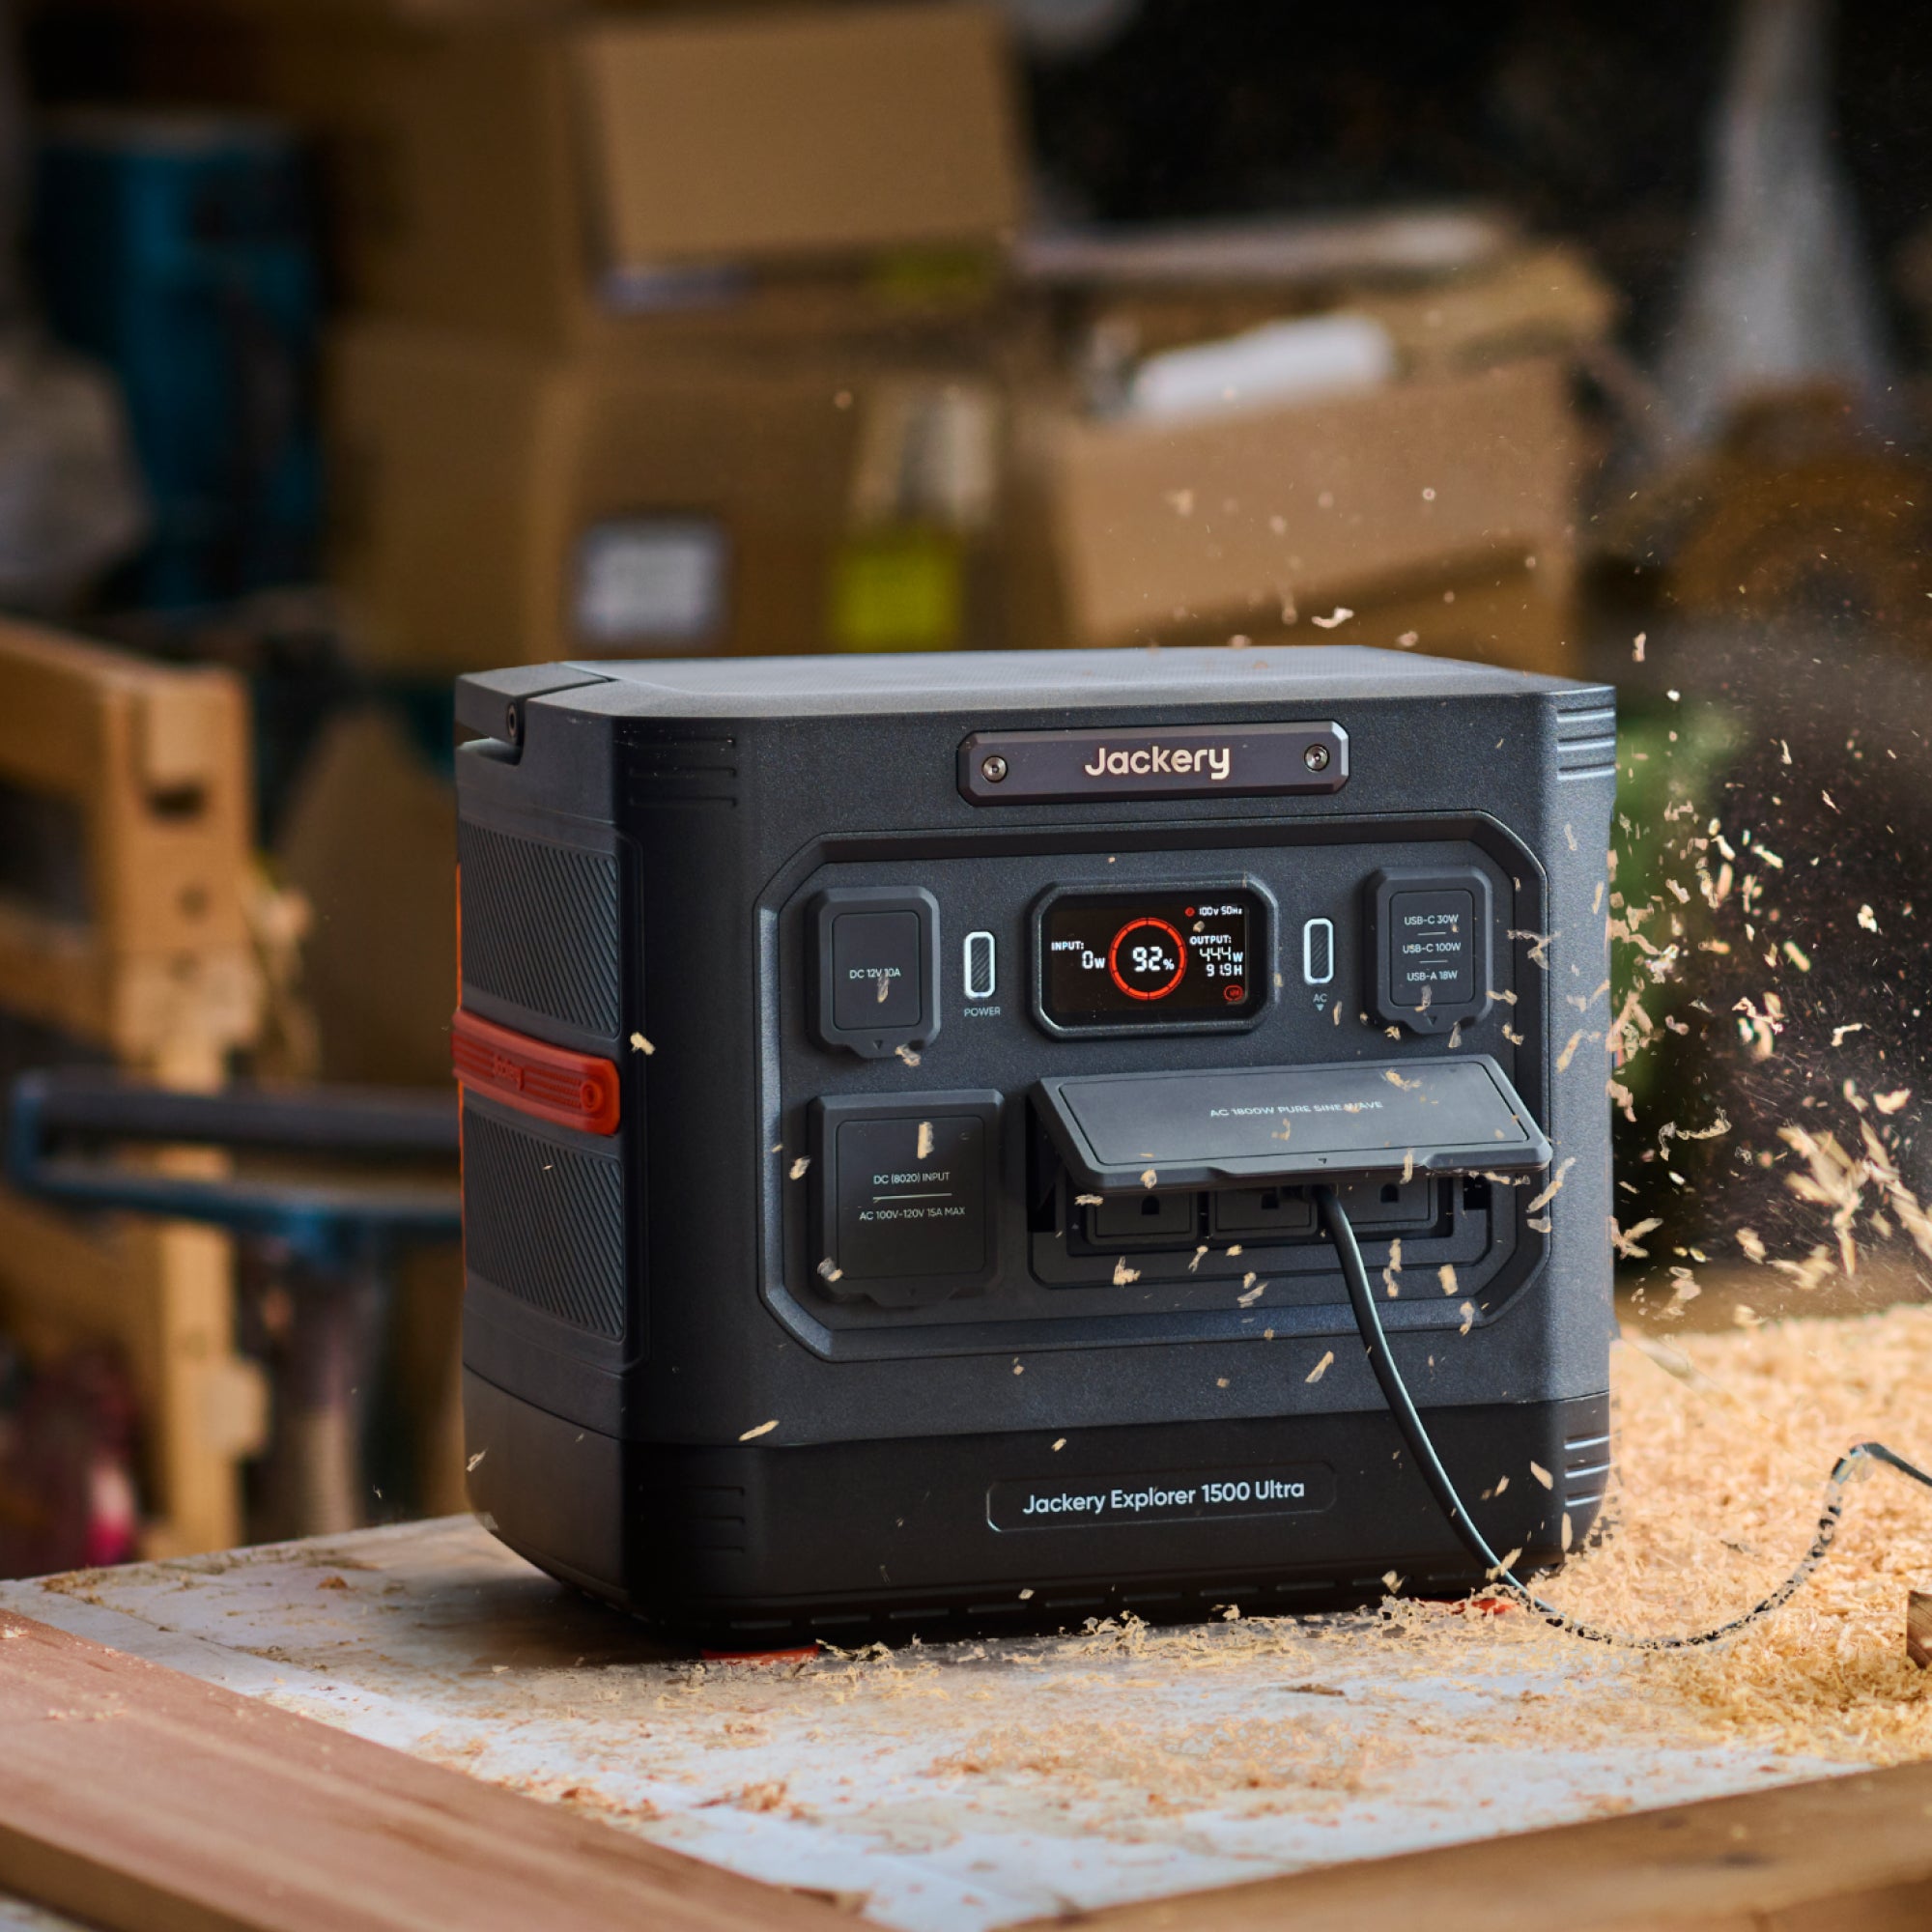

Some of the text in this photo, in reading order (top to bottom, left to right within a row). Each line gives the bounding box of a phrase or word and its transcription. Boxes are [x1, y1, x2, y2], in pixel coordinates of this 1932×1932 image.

[1084, 746, 1231, 780] Jackery
[1404, 914, 1459, 925] USB-C 30W
[1189, 934, 1232, 946] OUTPUT:
[1051, 941, 1085, 952] INPUT:
[1402, 941, 1462, 953] USB-C 100W
[849, 967, 902, 979] DC 12V 10A
[1406, 969, 1459, 981] USB-A 18W
[1313, 993, 1328, 1003] AC
[964, 1007, 1002, 1017] POWER
[1210, 1109, 1230, 1118] AC
[1231, 1106, 1276, 1116] 1800W
[1278, 1104, 1311, 1114] PURE
[1313, 1103, 1343, 1112] SINE
[873, 1172, 951, 1184] DC (8020) INPUT
[859, 1207, 966, 1221] AC 100V-120V 15A MAX
[1023, 1480, 1304, 1515] Jackery Explorer 1500 Ultra
